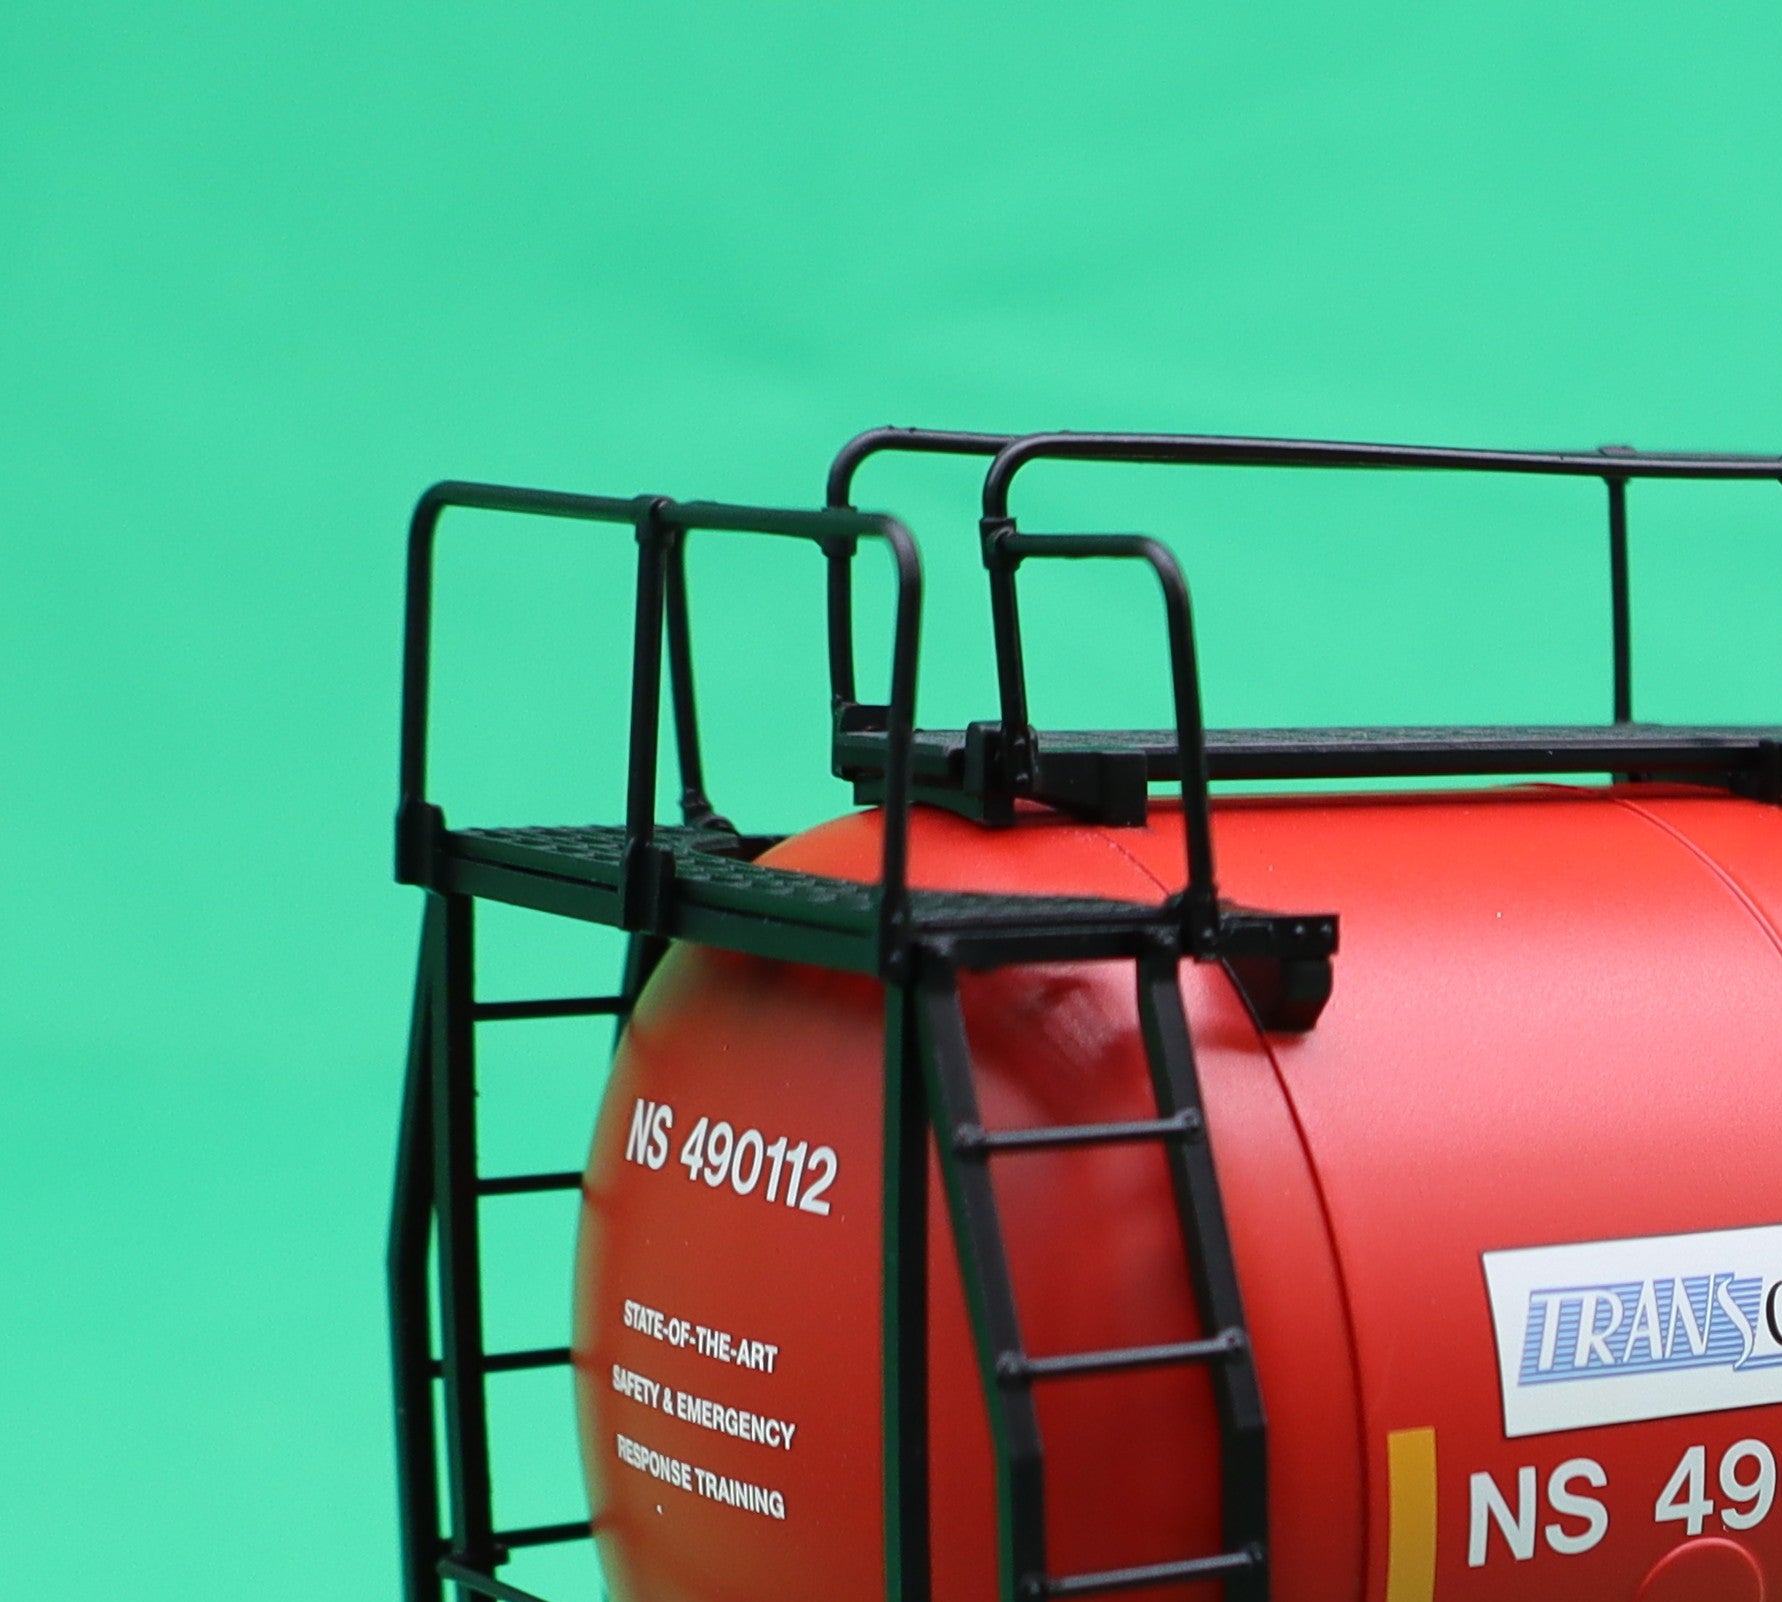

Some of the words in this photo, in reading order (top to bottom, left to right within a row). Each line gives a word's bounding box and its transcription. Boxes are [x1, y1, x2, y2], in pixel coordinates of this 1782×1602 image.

[625, 1098, 673, 1170] NS
[680, 1117, 838, 1216] 490112
[624, 1299, 779, 1374] STATE-OF-THE-ART
[612, 1364, 660, 1409] SAFETY
[662, 1387, 674, 1416] &
[677, 1391, 796, 1451] EMERGENCY
[616, 1433, 693, 1491] RESPONSE
[694, 1467, 786, 1520] TRAINING
[1467, 1457, 1609, 1568] NS
